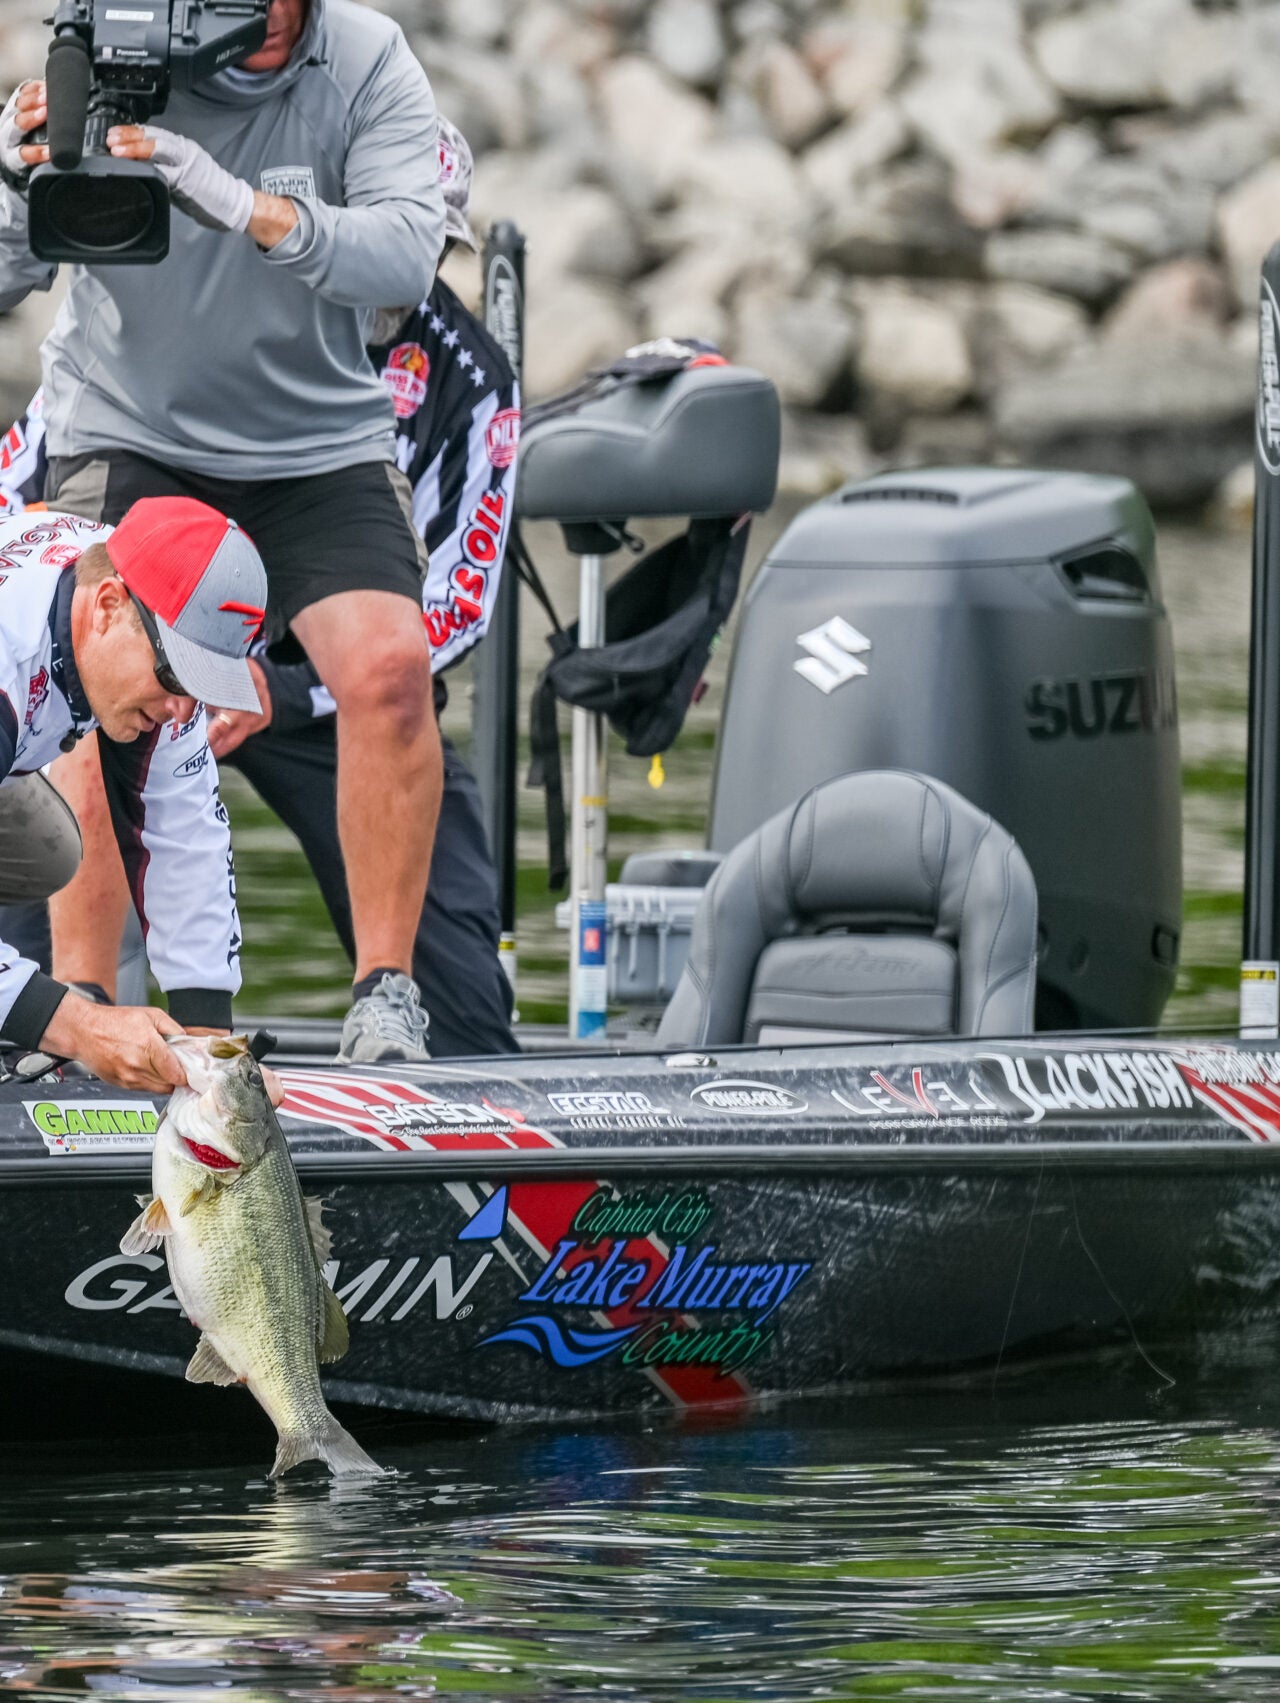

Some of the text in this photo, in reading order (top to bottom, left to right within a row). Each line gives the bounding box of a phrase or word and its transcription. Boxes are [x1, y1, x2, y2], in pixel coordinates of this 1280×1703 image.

[1024, 675, 1177, 743] SUZ
[33, 1102, 159, 1137] GAMMA
[365, 1103, 510, 1127] BATSON
[700, 1090, 794, 1107] POWER-POLE
[573, 1187, 713, 1247] Capital City
[64, 1252, 495, 1323] GMIN
[519, 1240, 812, 1327] Lake Murray
[622, 1321, 774, 1376] Country
